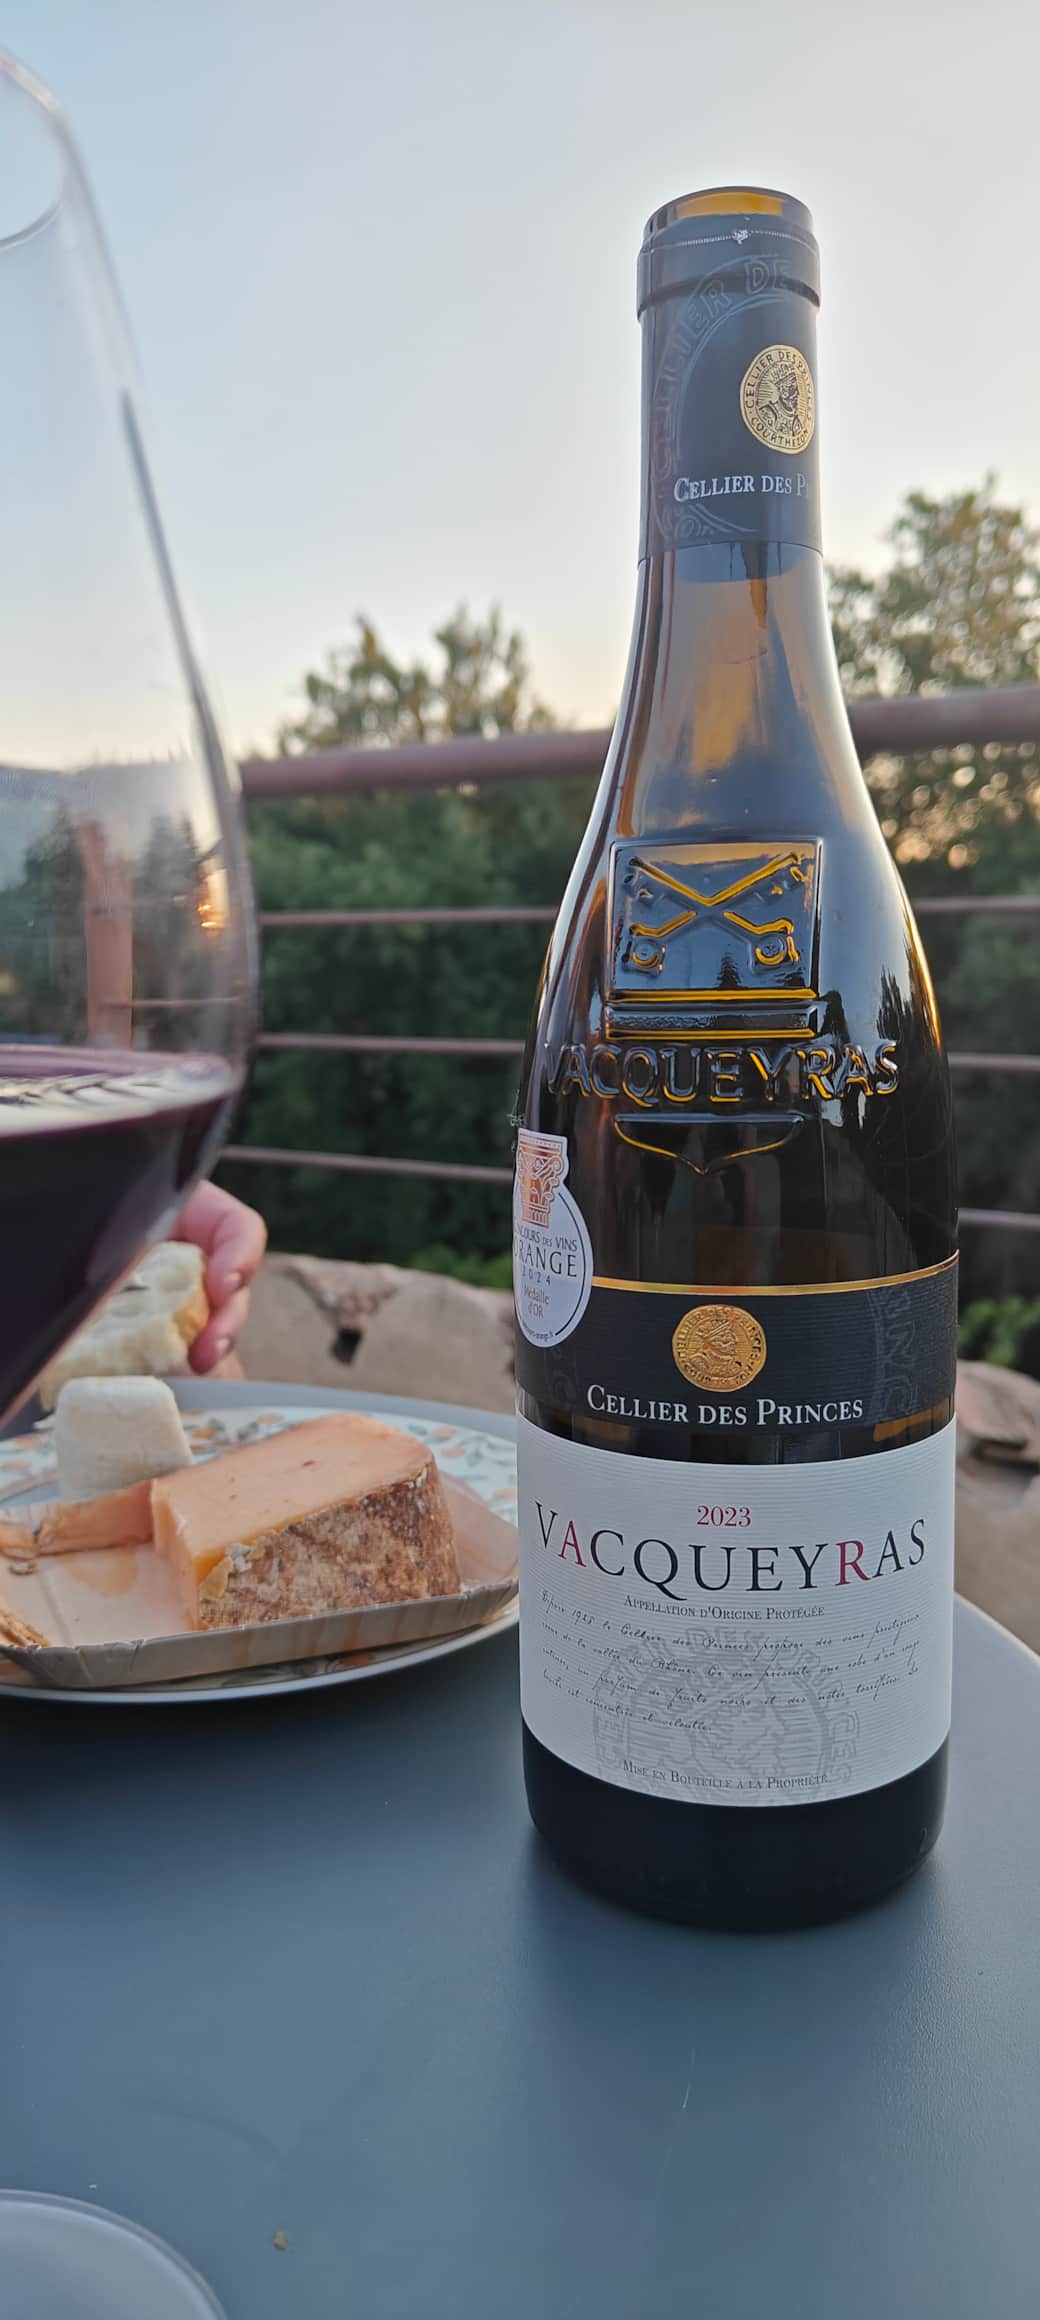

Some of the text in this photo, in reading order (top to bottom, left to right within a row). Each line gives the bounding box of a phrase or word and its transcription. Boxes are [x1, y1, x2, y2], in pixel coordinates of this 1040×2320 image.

[673, 475, 755, 502] CELLIER
[760, 474, 792, 494] DES
[545, 1039, 900, 1108] VACQUEYRAS
[555, 1236, 578, 1252] VINS
[522, 1268, 552, 1286] 2024
[587, 1384, 863, 1426] CELLIER DES PRINCES
[696, 1504, 752, 1528] 2023
[534, 1501, 926, 1601] VACQUEYRAS
[624, 1595, 695, 1617] APPELLATION
[700, 1606, 761, 1620] D'ORIGINE
[623, 1759, 648, 1777] MISE
